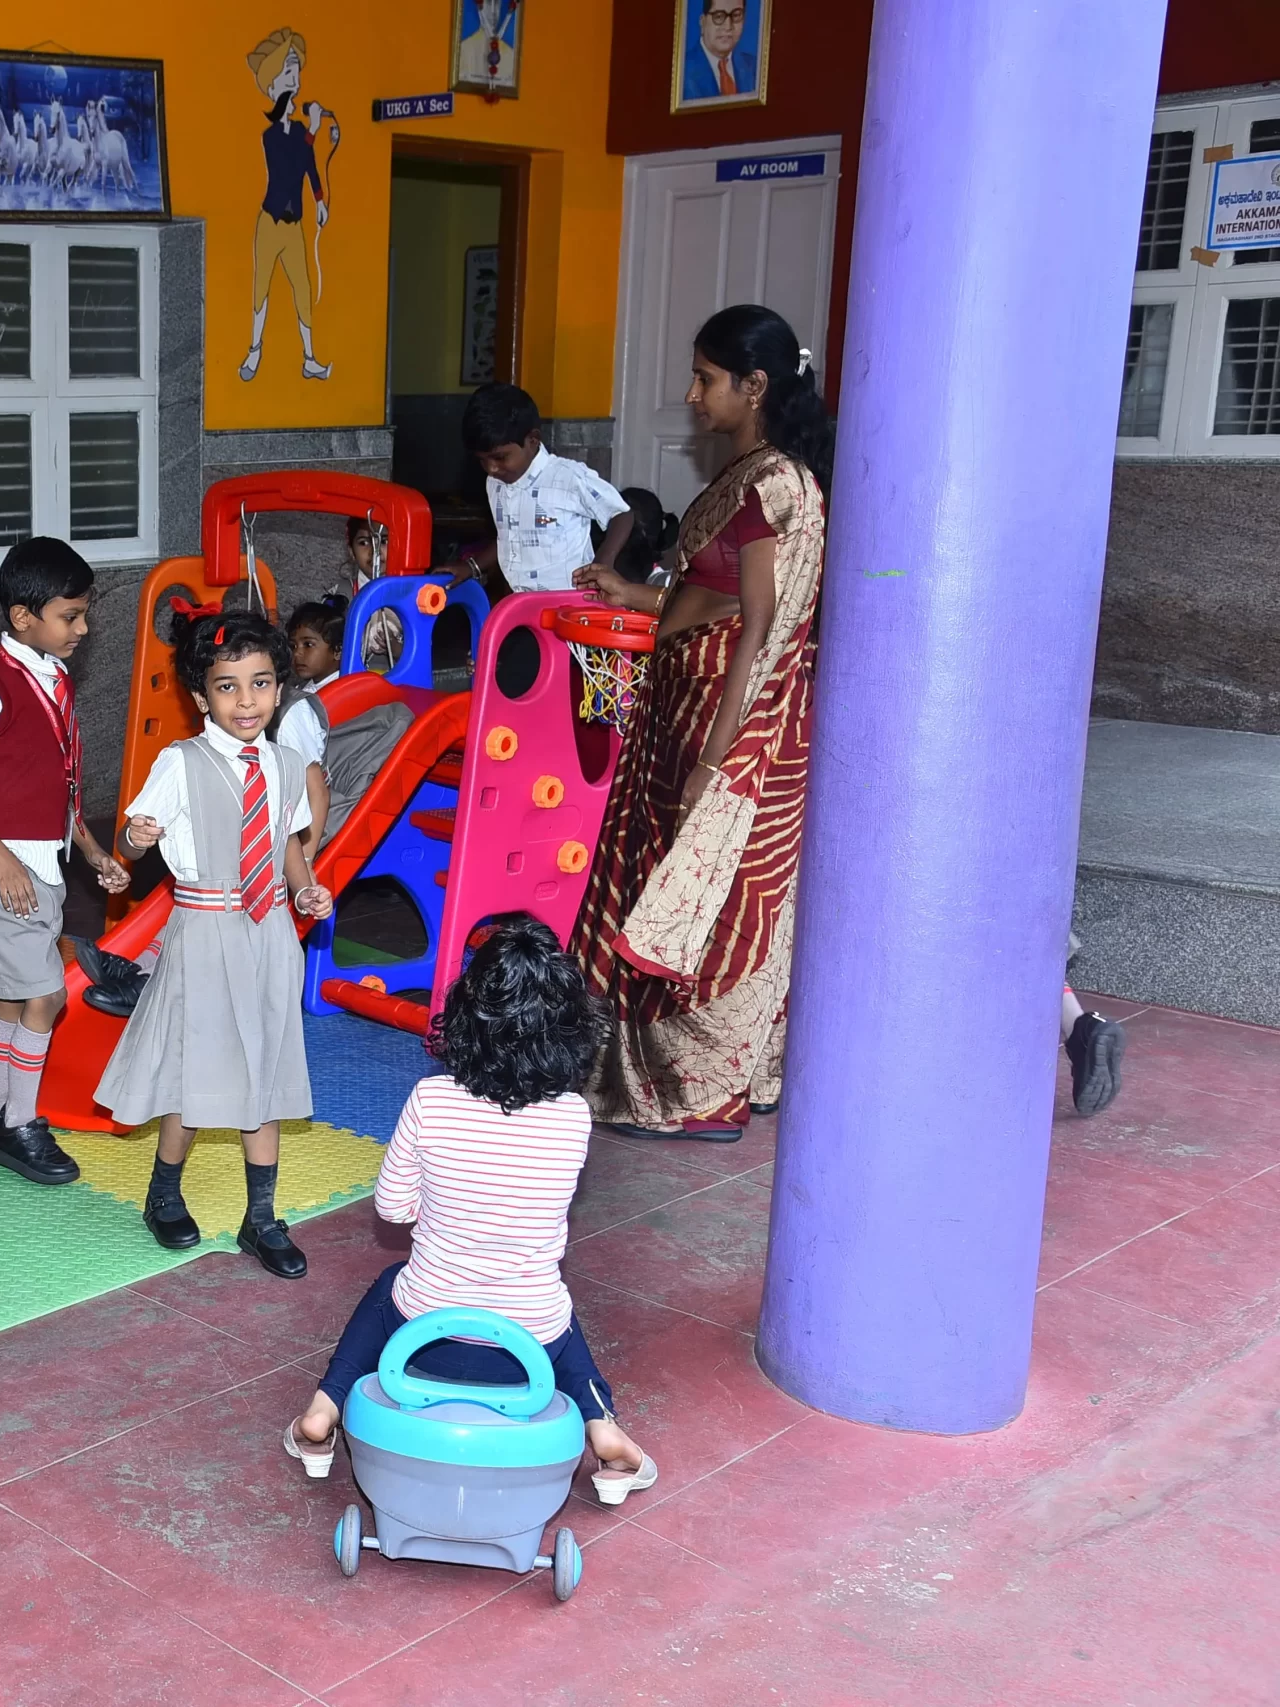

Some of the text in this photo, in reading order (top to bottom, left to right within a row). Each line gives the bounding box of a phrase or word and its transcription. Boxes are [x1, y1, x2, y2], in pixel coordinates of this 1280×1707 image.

[386, 102, 411, 117] UKG
[429, 98, 449, 112] Sec
[740, 161, 799, 177] AV ROOM
